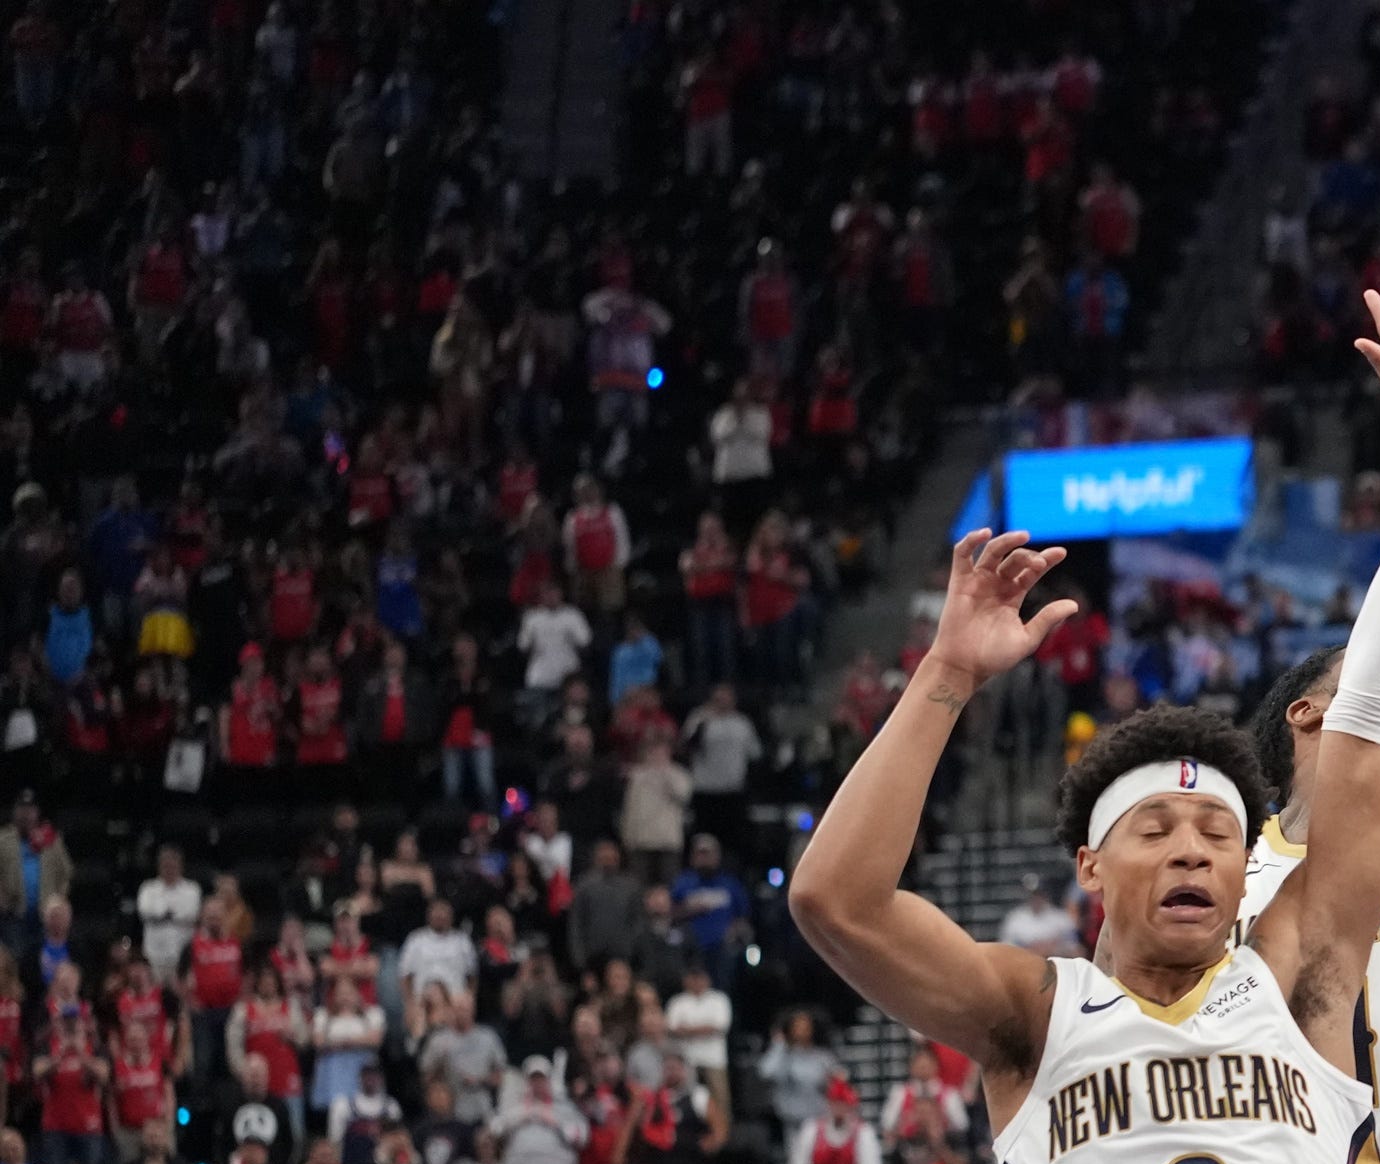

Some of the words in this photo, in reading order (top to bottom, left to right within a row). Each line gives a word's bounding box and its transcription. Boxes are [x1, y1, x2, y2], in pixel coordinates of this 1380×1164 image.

[1217, 996, 1251, 1018] GRILLS
[1048, 1061, 1132, 1164] NEW
[1146, 1053, 1317, 1135] ORLEANS
